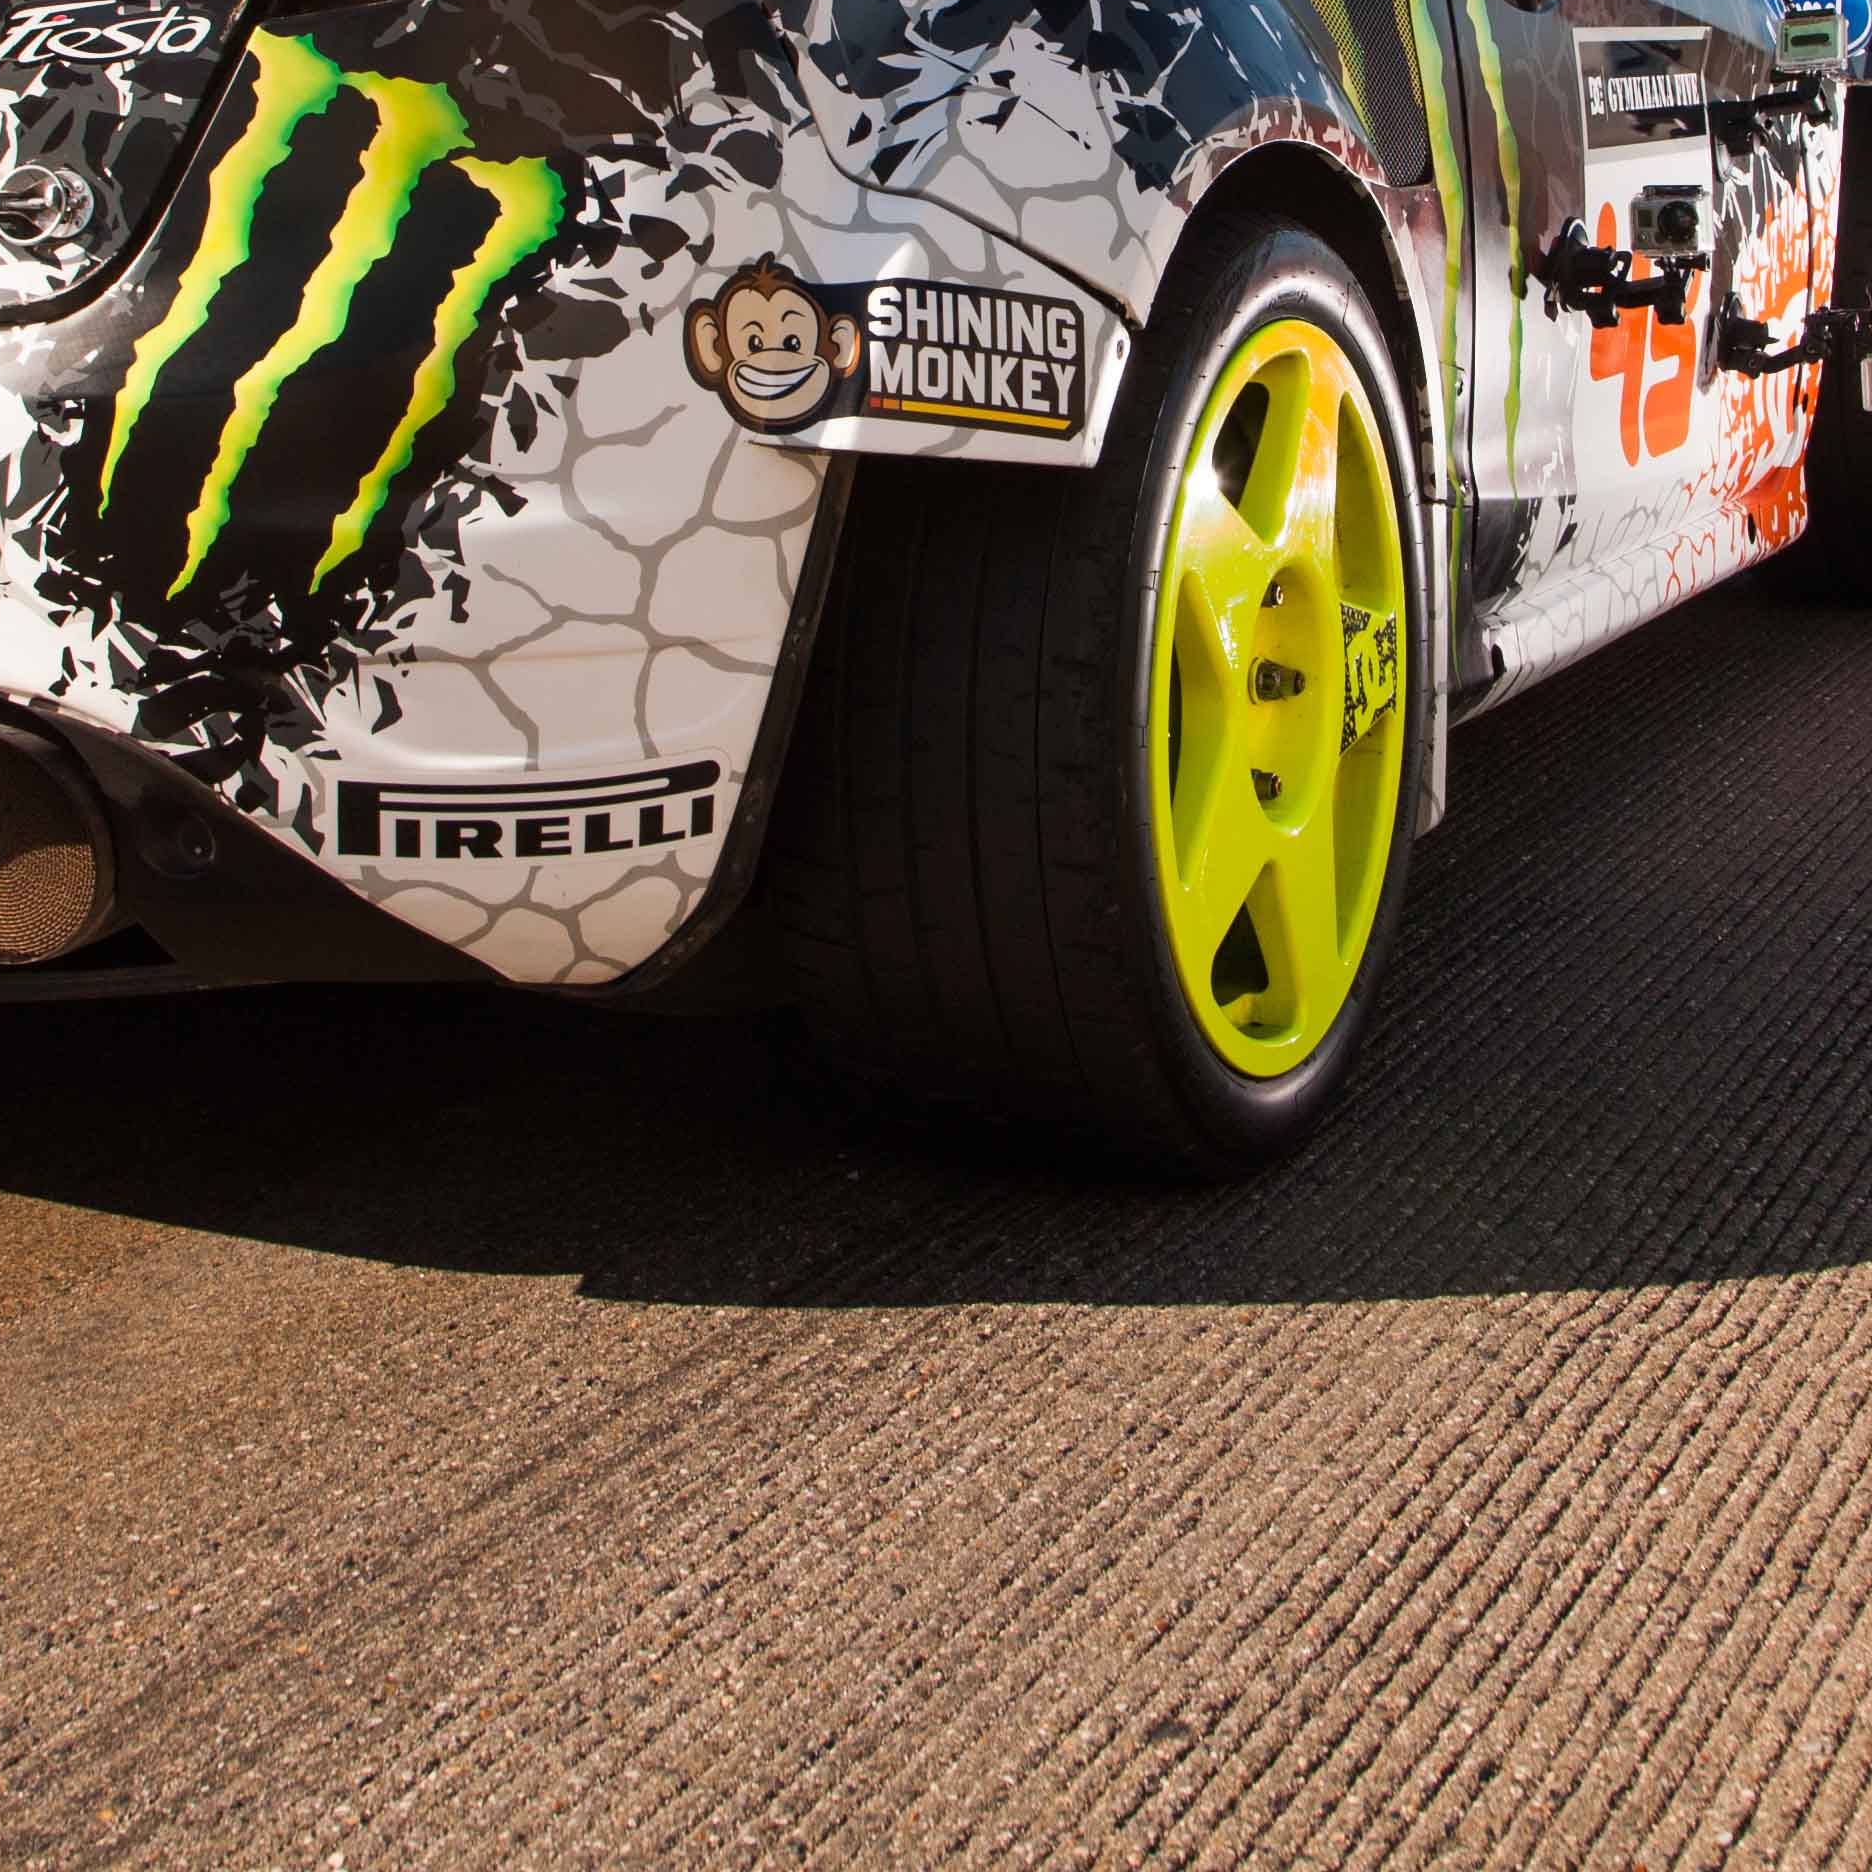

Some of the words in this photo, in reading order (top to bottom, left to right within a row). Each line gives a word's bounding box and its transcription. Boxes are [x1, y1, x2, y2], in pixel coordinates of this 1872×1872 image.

[867, 284, 1079, 359] SHINING
[868, 337, 1079, 416] MONKEY
[336, 757, 722, 861] PIRELLI
